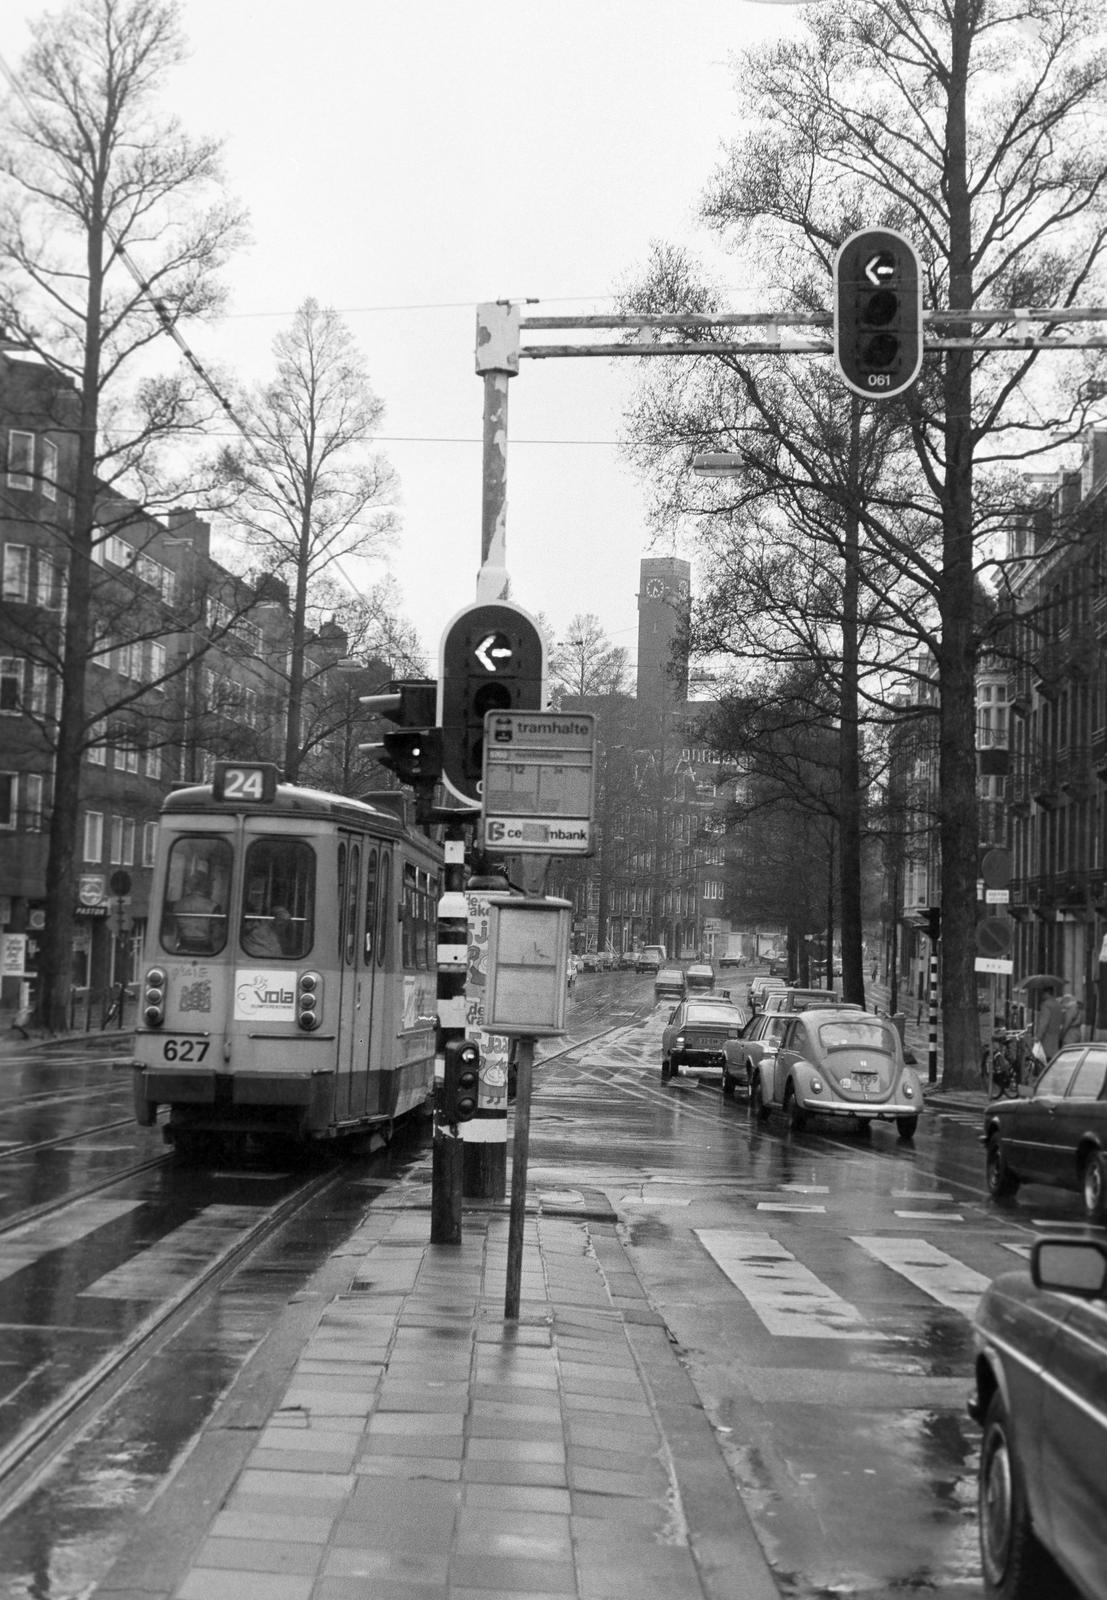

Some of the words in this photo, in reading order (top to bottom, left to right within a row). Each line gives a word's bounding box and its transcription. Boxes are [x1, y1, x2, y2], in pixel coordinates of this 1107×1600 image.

[868, 374, 891, 386] 061
[517, 722, 589, 735] tramhalte
[223, 769, 263, 799] 24
[254, 988, 294, 1004] vola
[163, 1040, 211, 1063] 627
